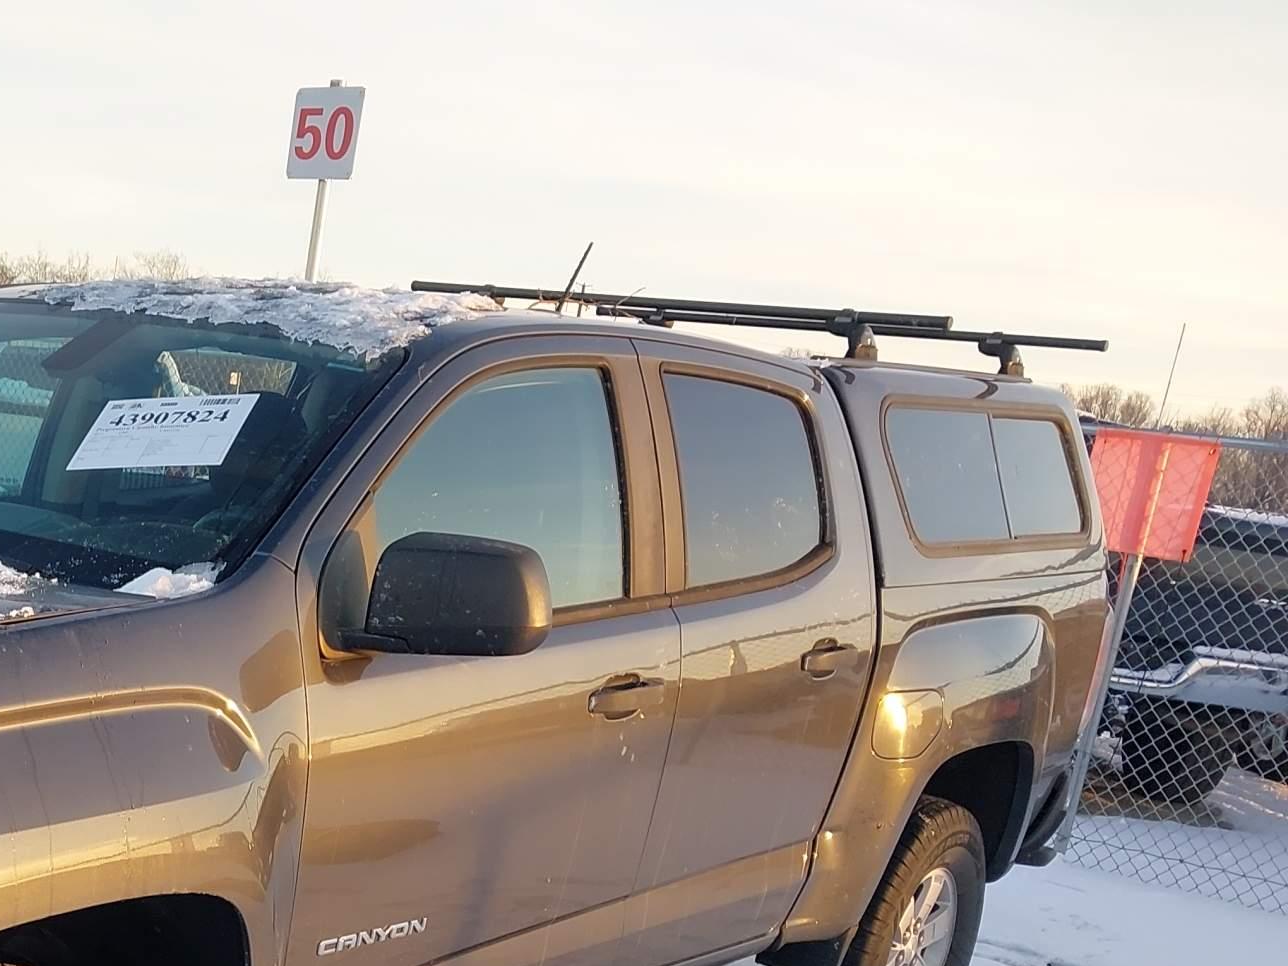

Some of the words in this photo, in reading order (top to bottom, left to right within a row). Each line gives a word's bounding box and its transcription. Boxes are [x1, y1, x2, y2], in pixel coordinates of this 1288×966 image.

[294, 105, 354, 160] 50
[109, 408, 231, 427] 43907824
[317, 917, 428, 957] CANYON
